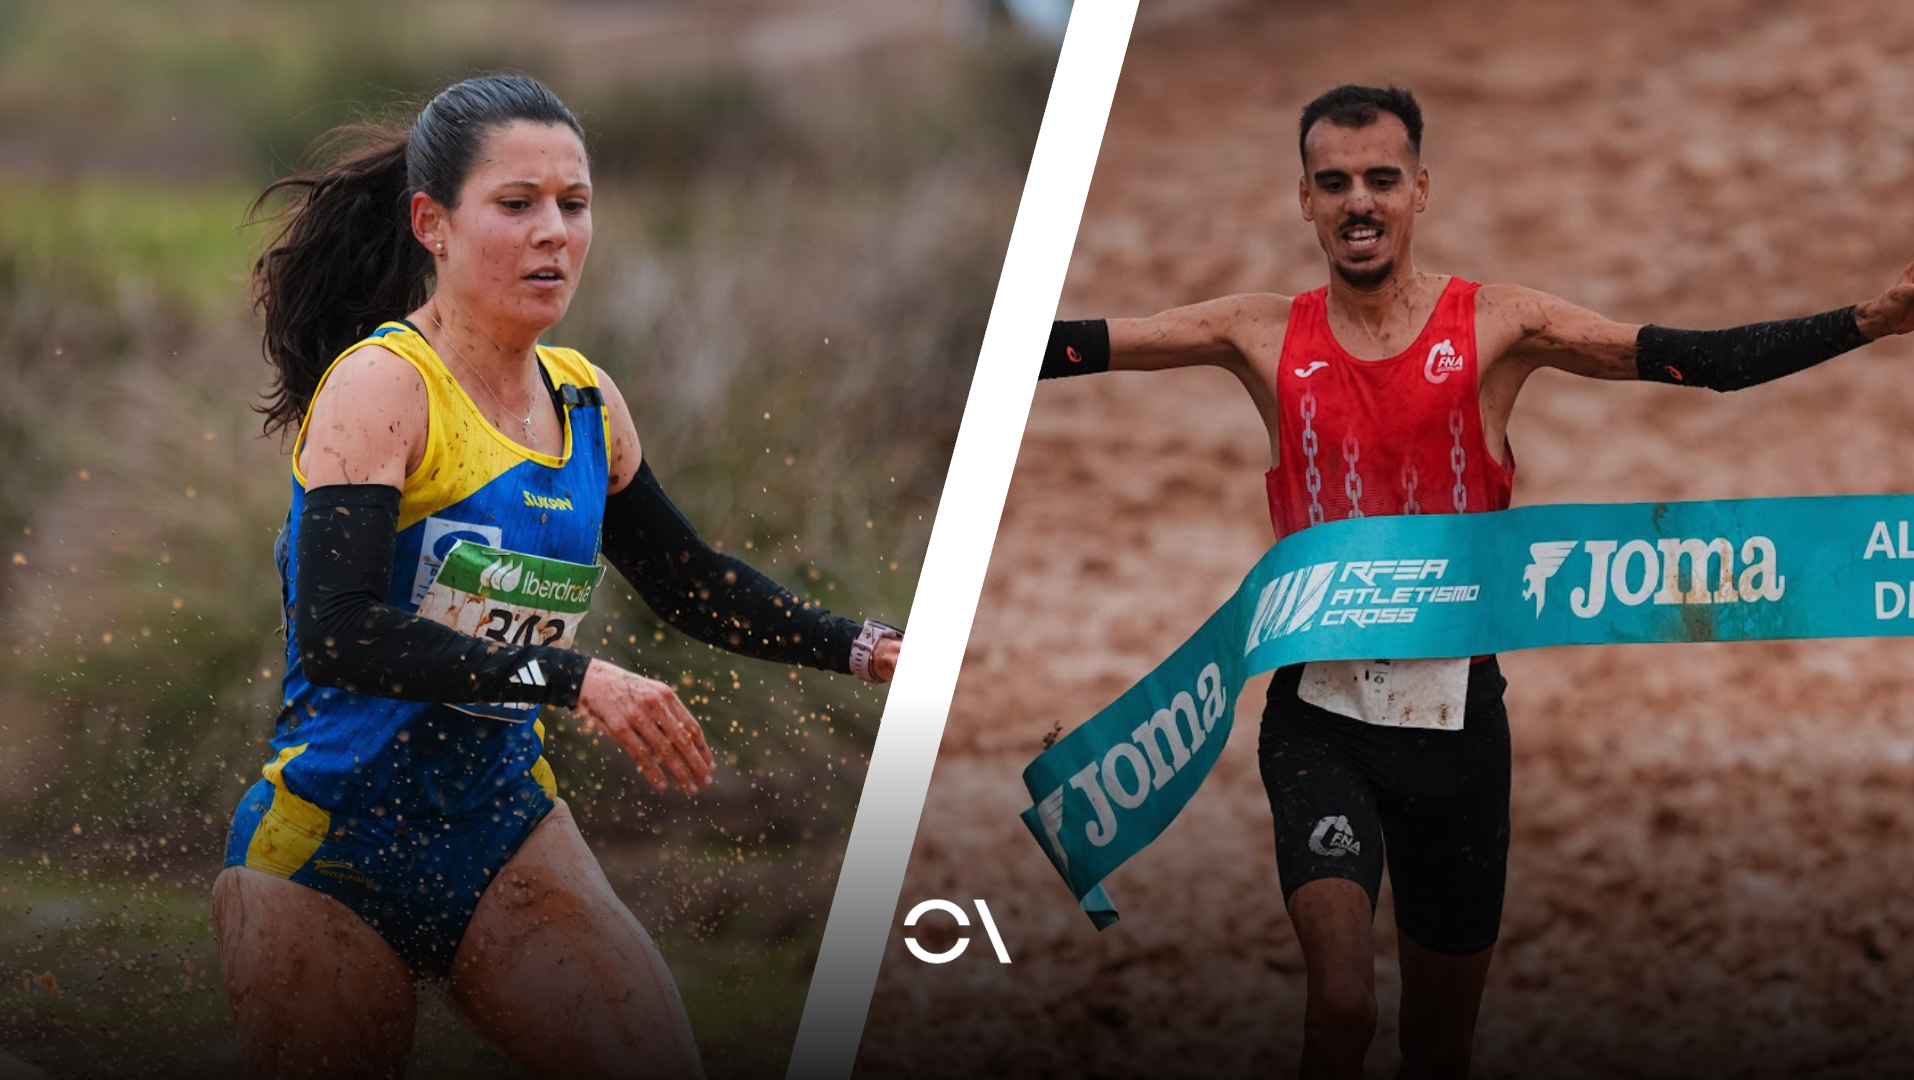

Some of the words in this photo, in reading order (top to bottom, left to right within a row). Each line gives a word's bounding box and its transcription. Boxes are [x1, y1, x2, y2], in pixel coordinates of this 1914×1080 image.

[1339, 559, 1449, 586] RFEA
[521, 571, 591, 603] Iberdrola
[1331, 585, 1480, 605] ATLETISMO
[1320, 608, 1418, 627] CROSS
